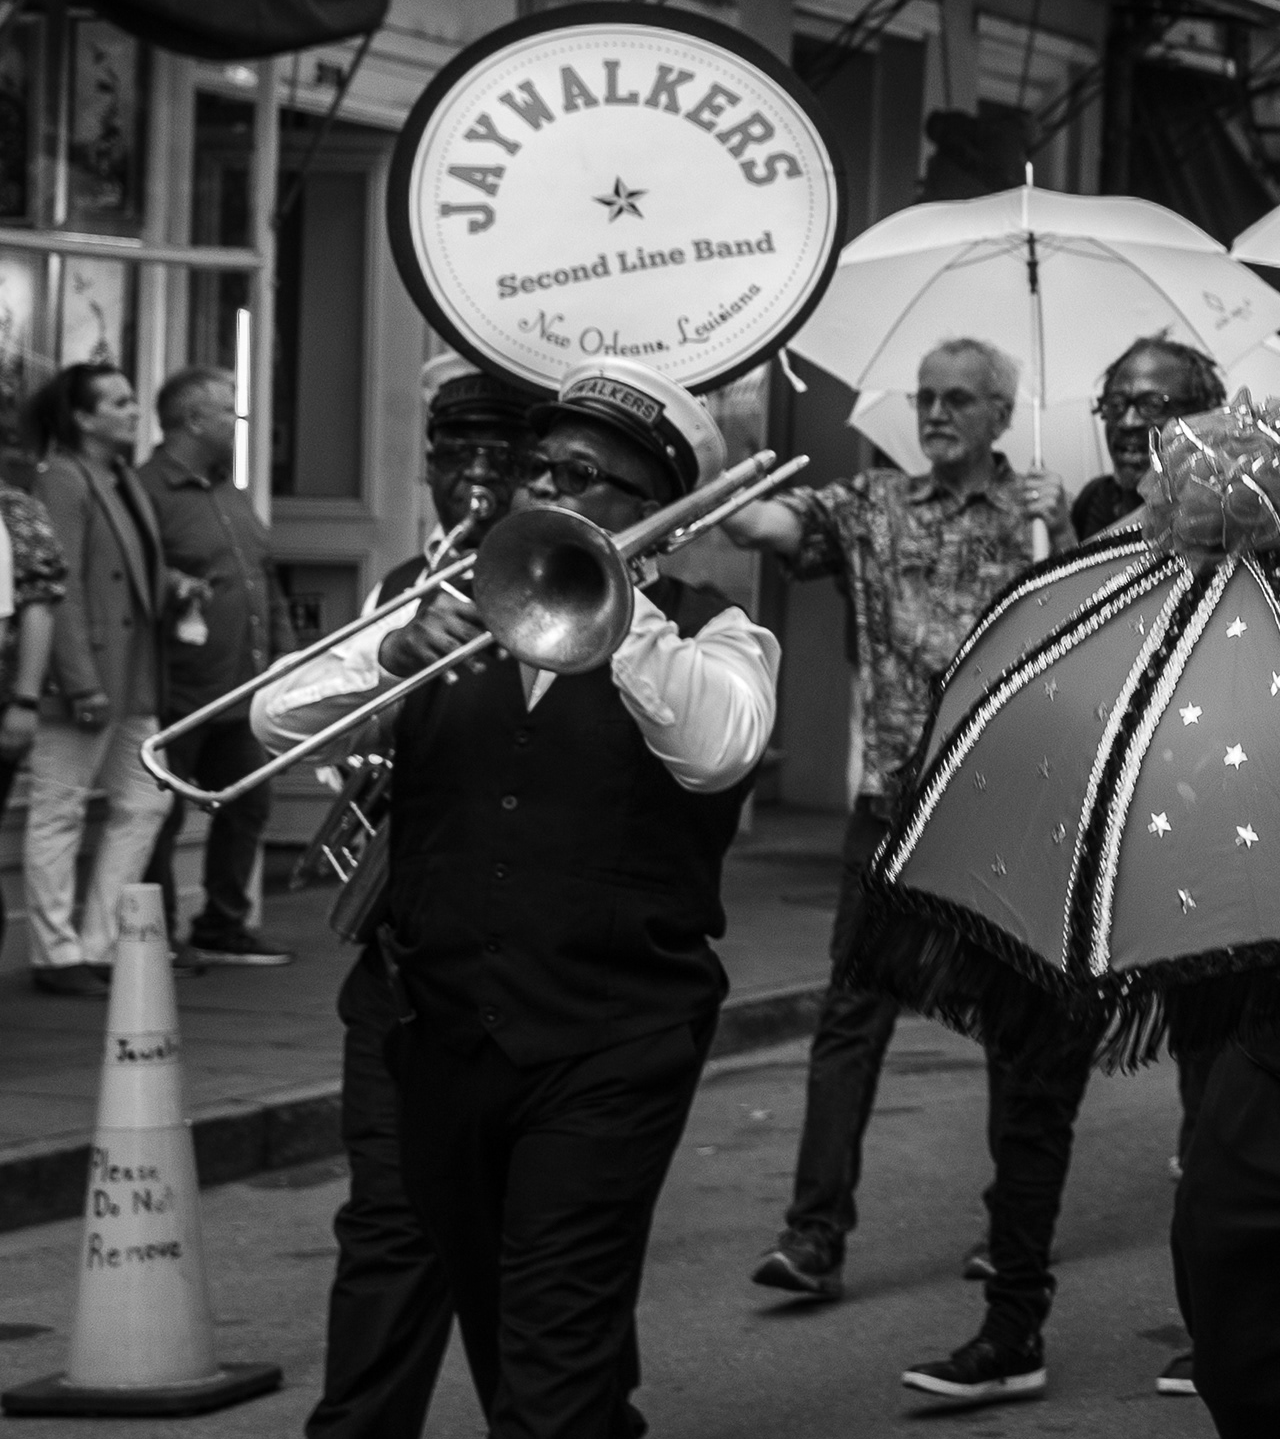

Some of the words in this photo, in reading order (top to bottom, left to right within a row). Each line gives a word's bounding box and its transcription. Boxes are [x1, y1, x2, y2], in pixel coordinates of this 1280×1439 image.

[438, 59, 803, 234] JAYWALKERS
[497, 253, 612, 299] Second
[617, 247, 686, 275] Line
[691, 231, 776, 262] Band
[517, 309, 571, 348] New
[677, 283, 762, 345] Louisiana
[93, 1189, 120, 1218] Do
